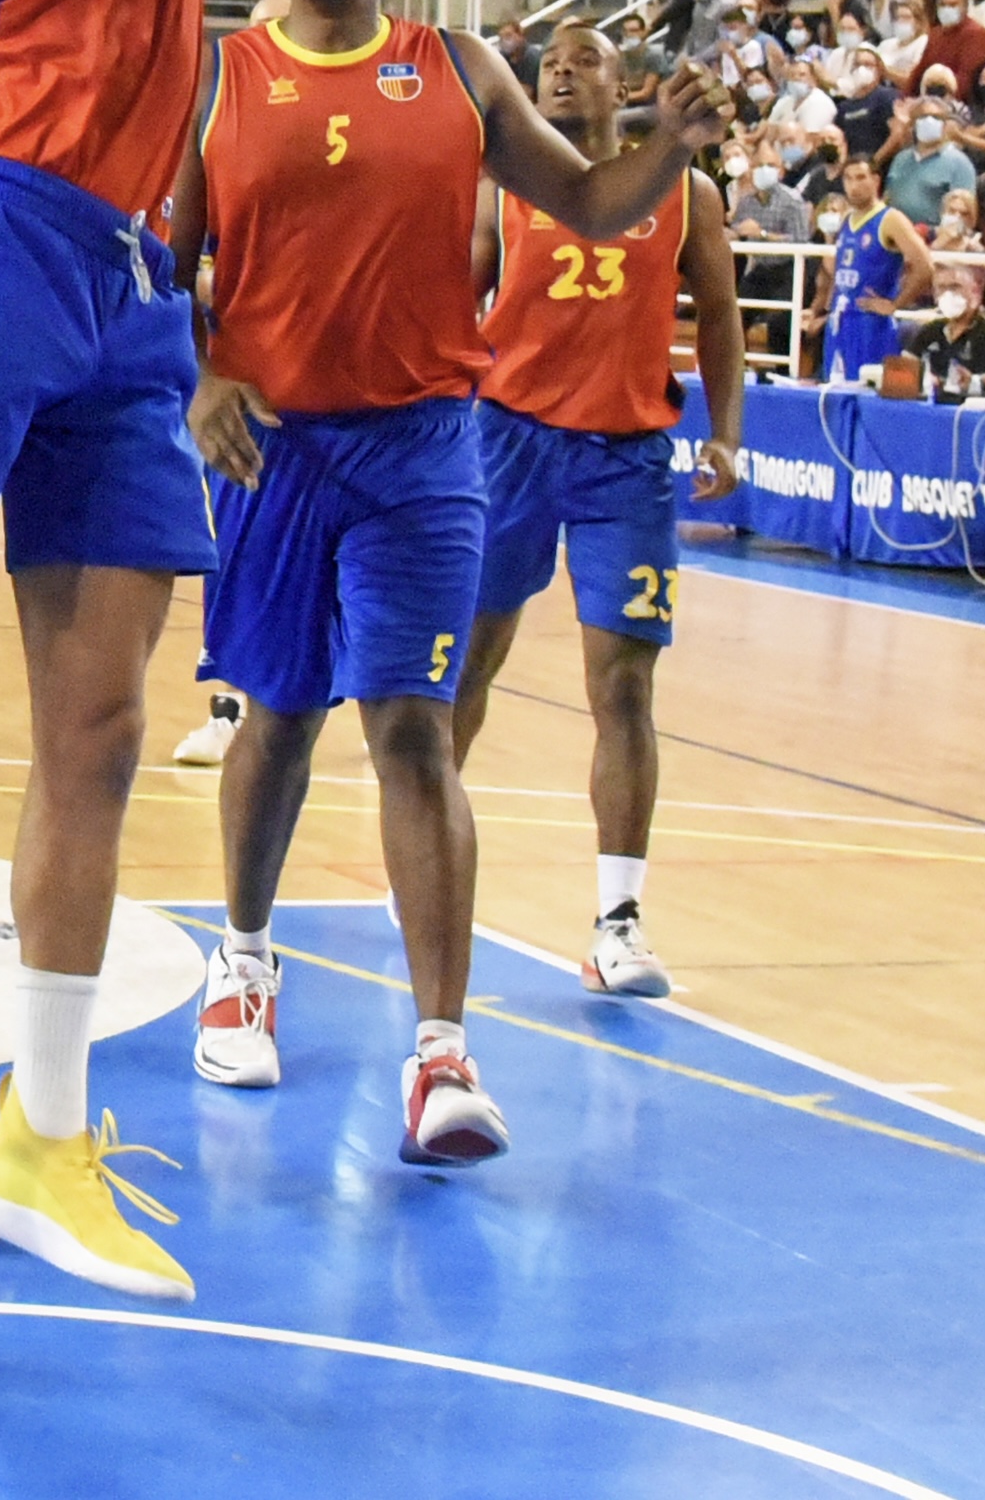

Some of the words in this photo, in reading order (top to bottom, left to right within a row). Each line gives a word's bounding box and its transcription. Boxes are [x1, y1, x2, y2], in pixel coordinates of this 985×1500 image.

[326, 115, 351, 165] 5
[548, 245, 627, 300] 23
[852, 469, 893, 508] CLUB
[427, 633, 454, 683] 5
